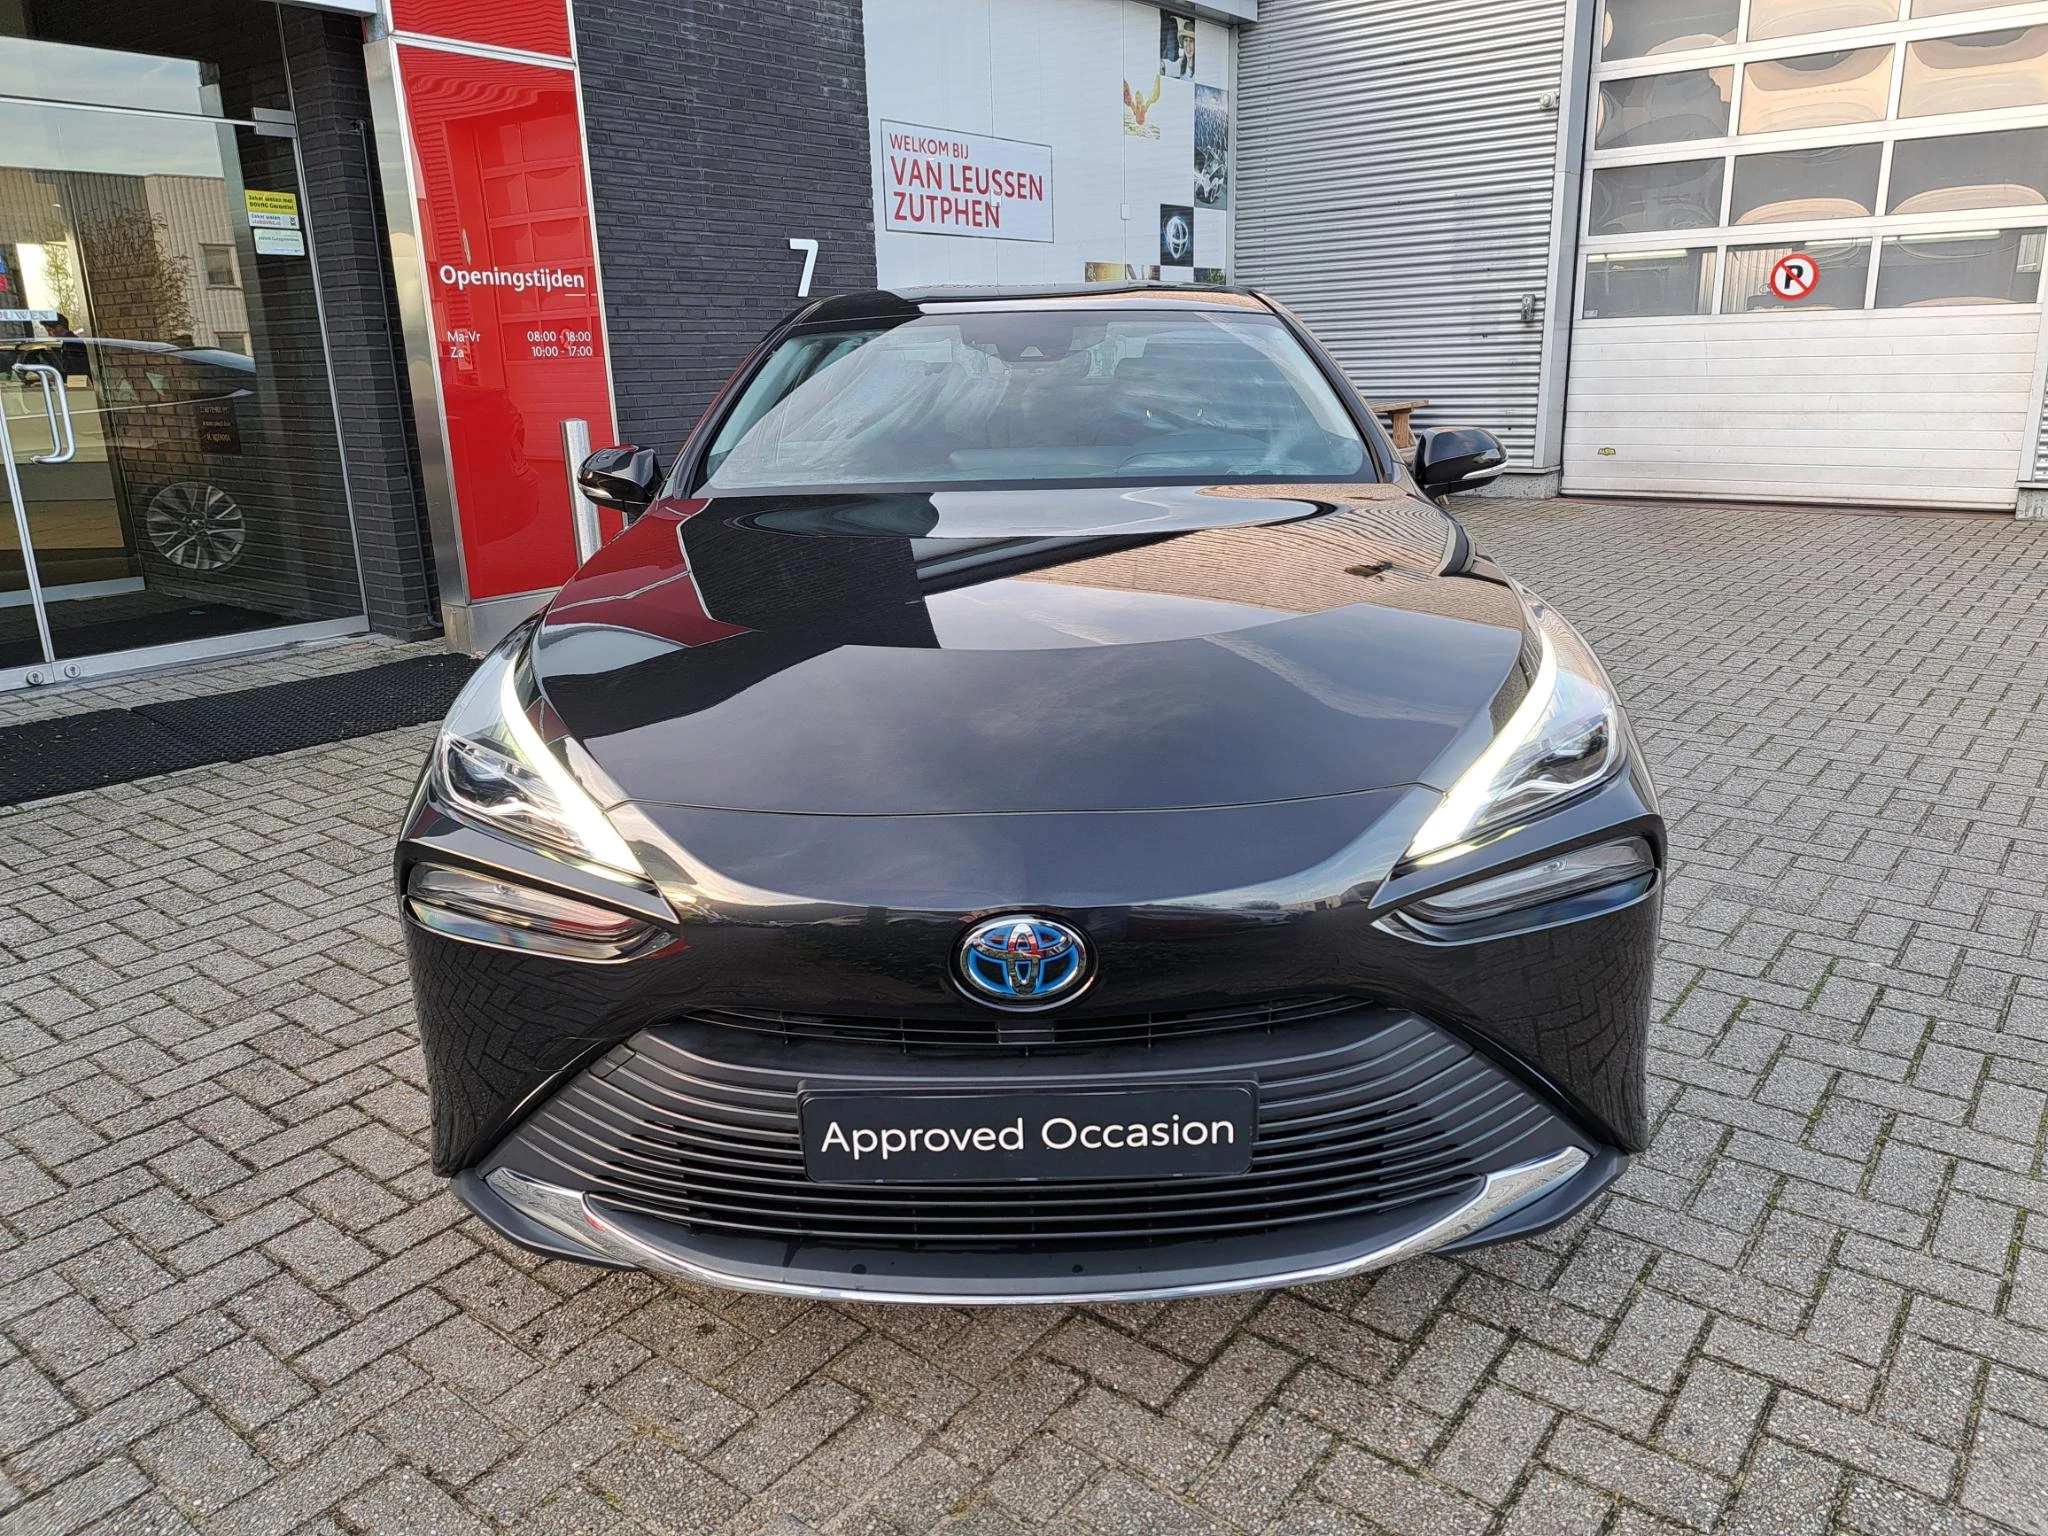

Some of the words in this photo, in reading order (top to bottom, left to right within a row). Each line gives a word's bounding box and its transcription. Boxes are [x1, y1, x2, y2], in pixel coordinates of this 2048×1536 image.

[889, 133, 949, 157] WELKOM
[952, 143, 969, 160] BIJ
[890, 155, 942, 190] VAN
[949, 163, 1043, 202] LEUSSEN
[893, 191, 1000, 229] ZUTPHEN
[440, 265, 585, 292] Openingstijden
[789, 238, 819, 298] 7
[1784, 265, 1804, 290] P
[447, 331, 480, 343] Ma-Vr
[527, 331, 556, 342] 08:00
[566, 331, 591, 342] 18:00
[450, 347, 464, 358] Za
[532, 346, 558, 357] 10:00
[568, 346, 593, 357] 17:00
[820, 1117, 1024, 1161] Approved
[1041, 1114, 1235, 1151] Occasion
